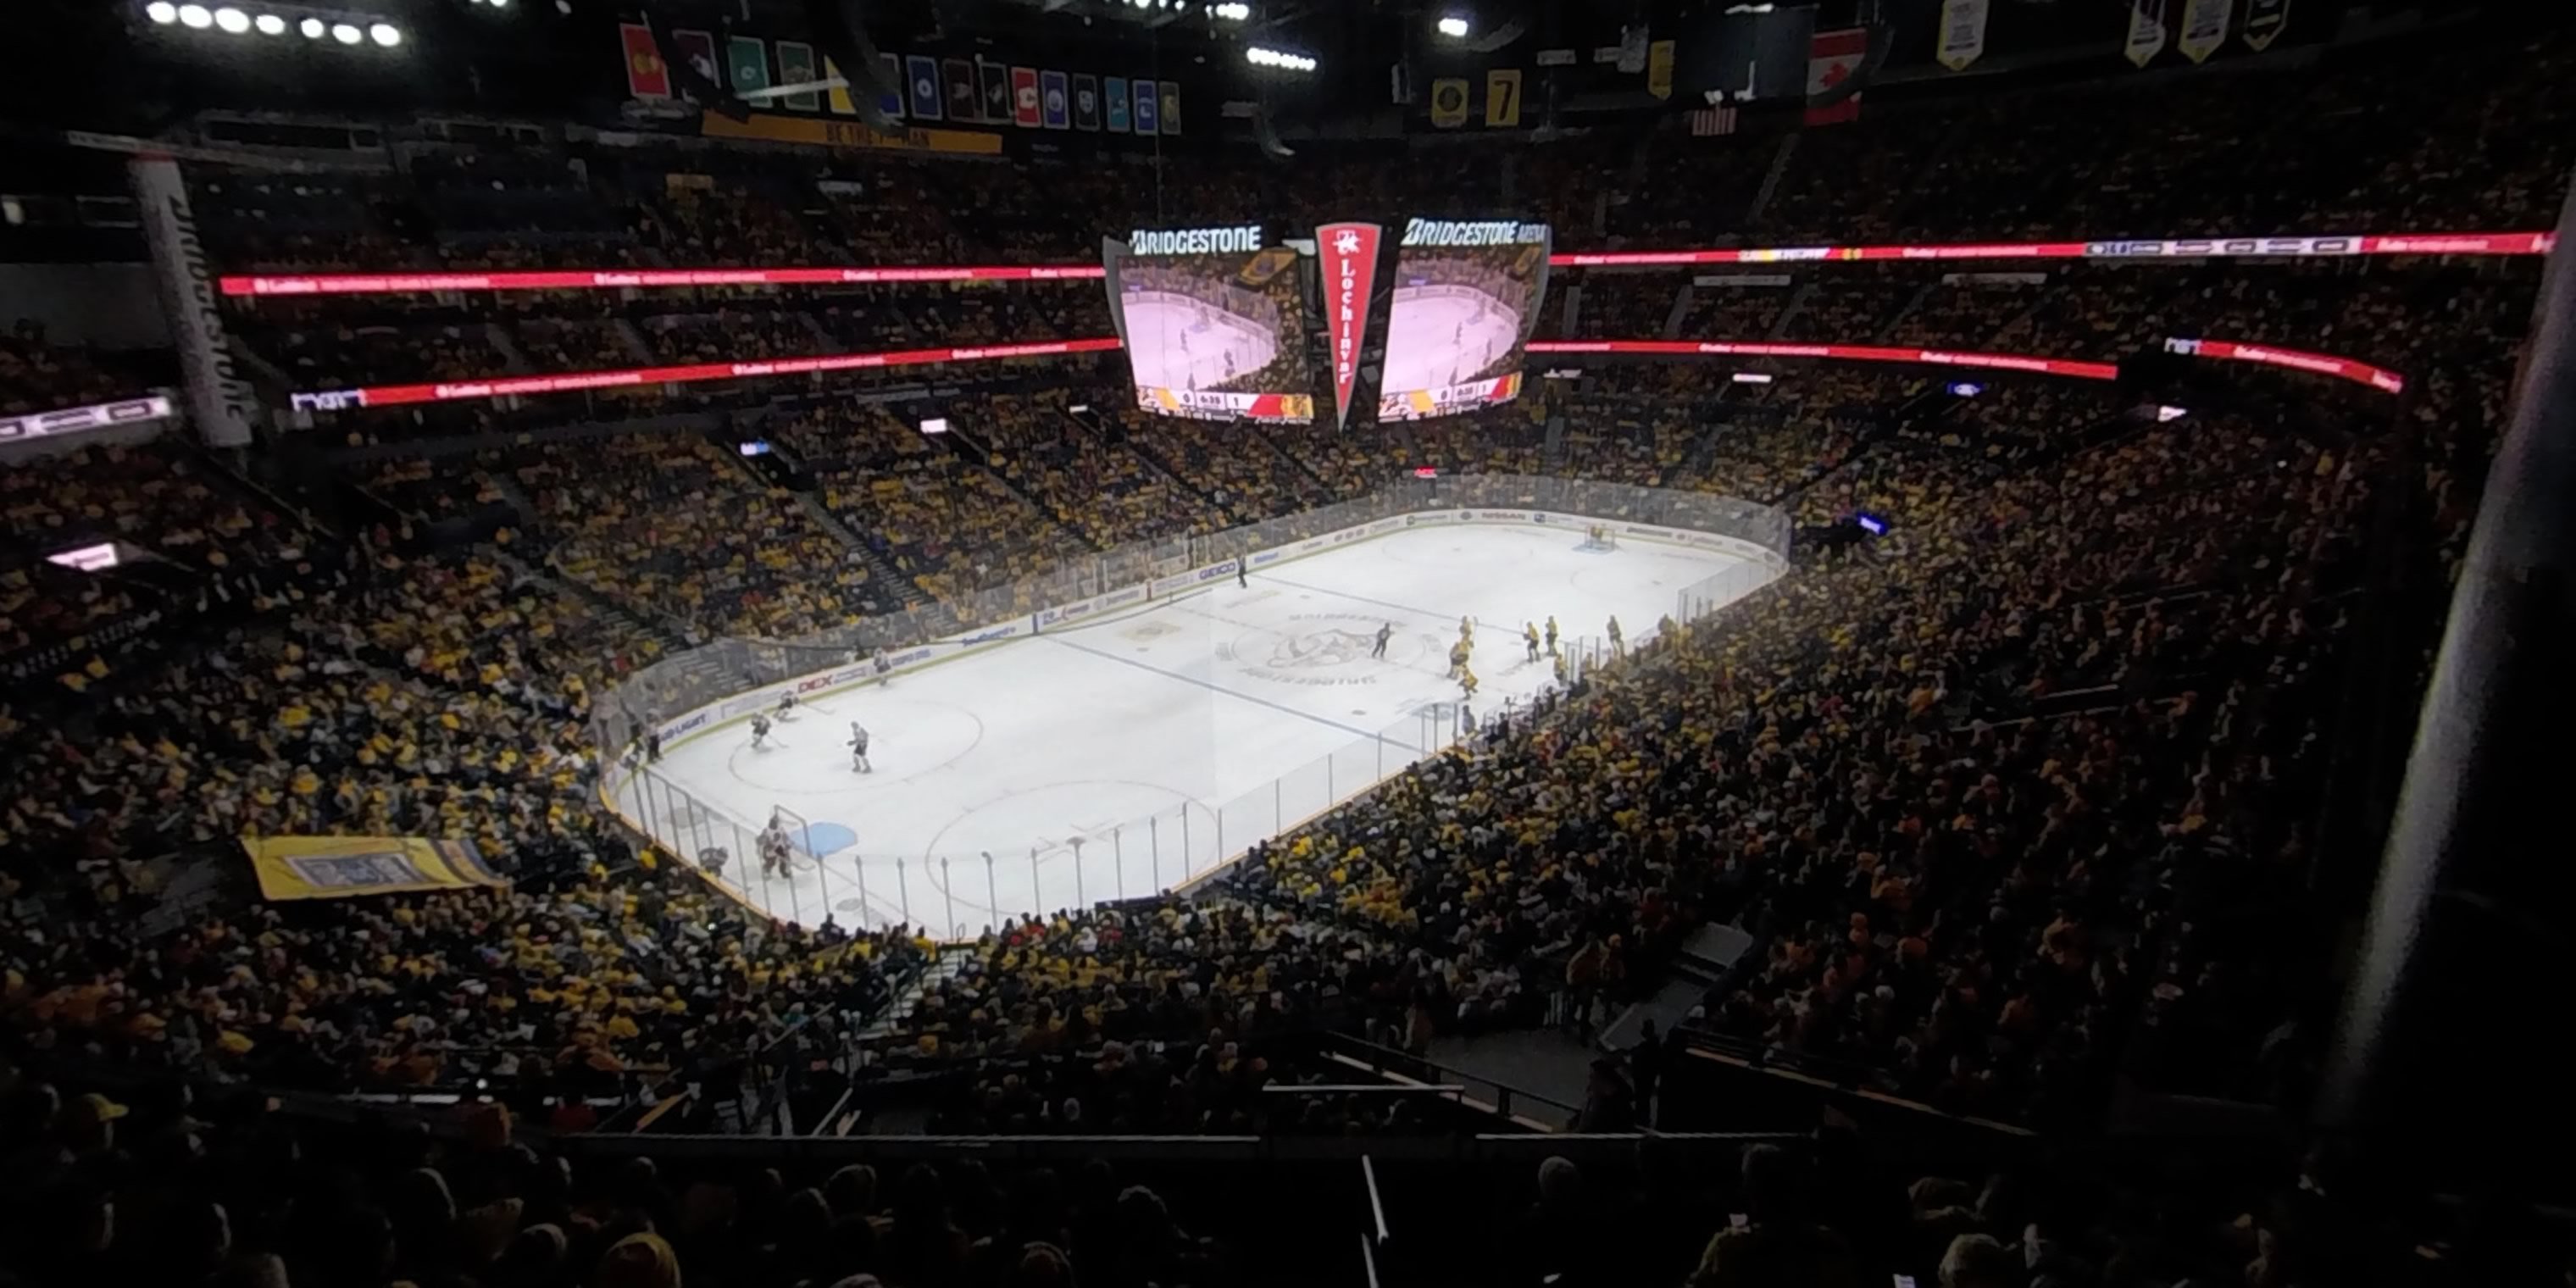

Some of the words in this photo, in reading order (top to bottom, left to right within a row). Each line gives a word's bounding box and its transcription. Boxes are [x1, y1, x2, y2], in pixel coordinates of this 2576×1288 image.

[1493, 80, 1513, 120] 7
[1129, 225, 1263, 256] BRIDGESTONE
[1400, 218, 1519, 247] BRIDGESTONE
[1339, 258, 1357, 384] Lochinvar
[1198, 562, 1237, 580] GEICO
